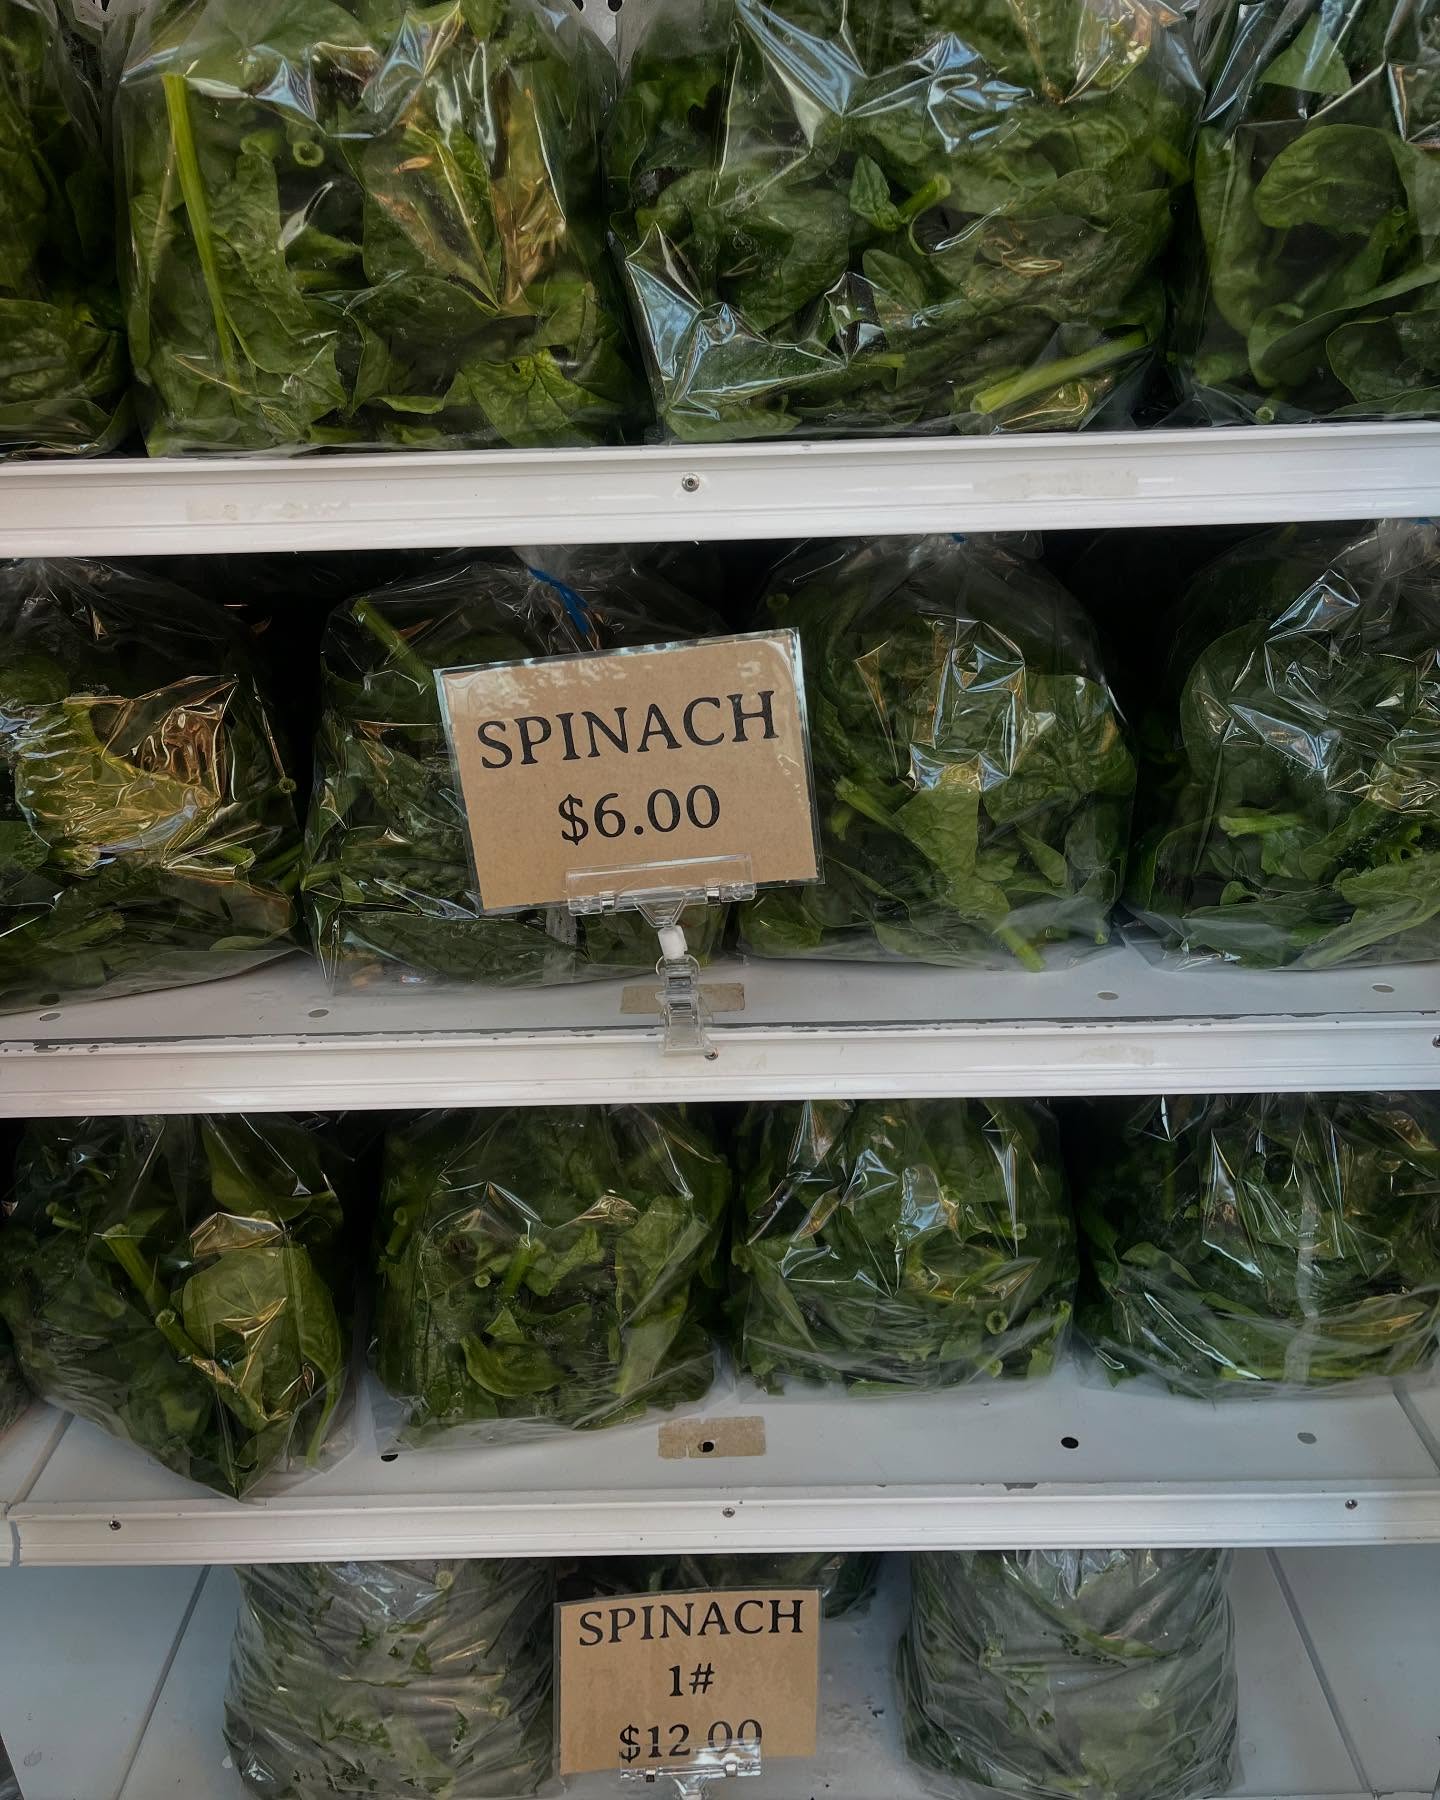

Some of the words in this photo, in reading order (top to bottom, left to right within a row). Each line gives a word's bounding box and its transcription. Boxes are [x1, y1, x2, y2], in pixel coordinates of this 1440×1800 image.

[477, 690, 779, 768] SPINACH
[558, 785, 720, 846] $6.00
[579, 1600, 803, 1646] SPINACH
[668, 1662, 715, 1696] 1#
[619, 1718, 762, 1763] $1200
